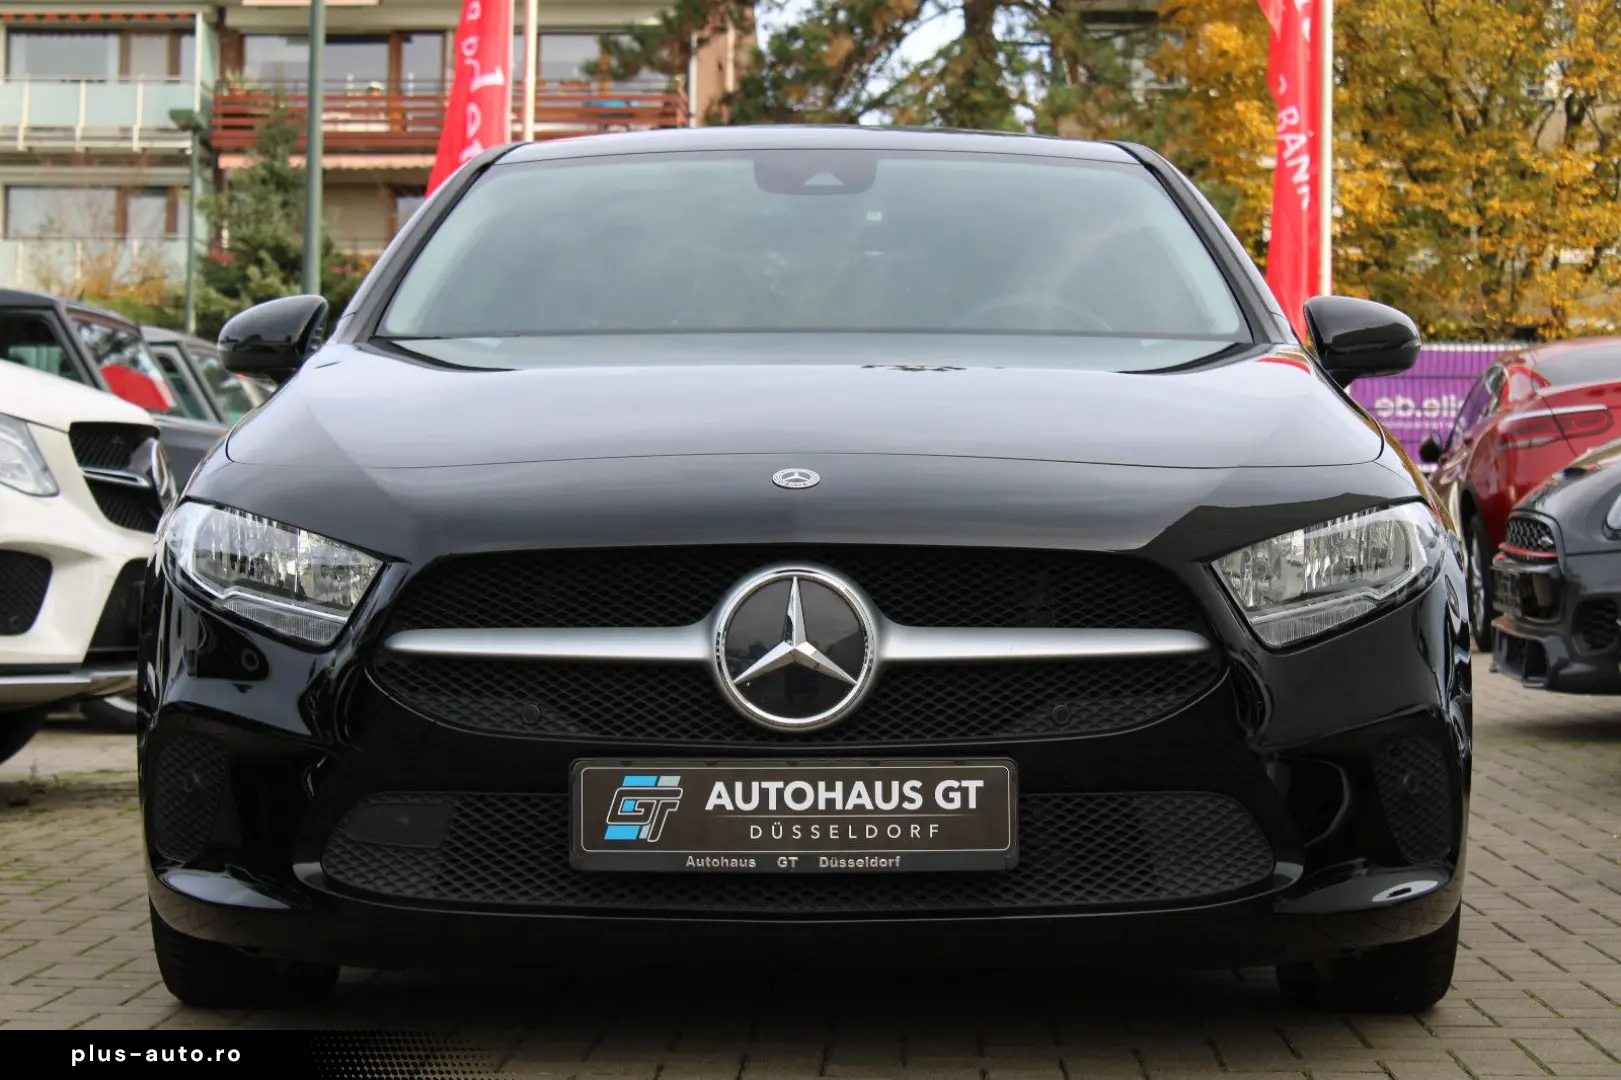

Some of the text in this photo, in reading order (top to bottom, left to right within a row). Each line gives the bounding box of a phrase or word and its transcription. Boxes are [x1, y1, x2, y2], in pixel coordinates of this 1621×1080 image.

[705, 779, 984, 812] AUTOHAUS GT
[606, 786, 684, 843] GT
[749, 822, 940, 840] DÜSSELDORF
[685, 855, 901, 869] Autohaus GT Düsseldorf
